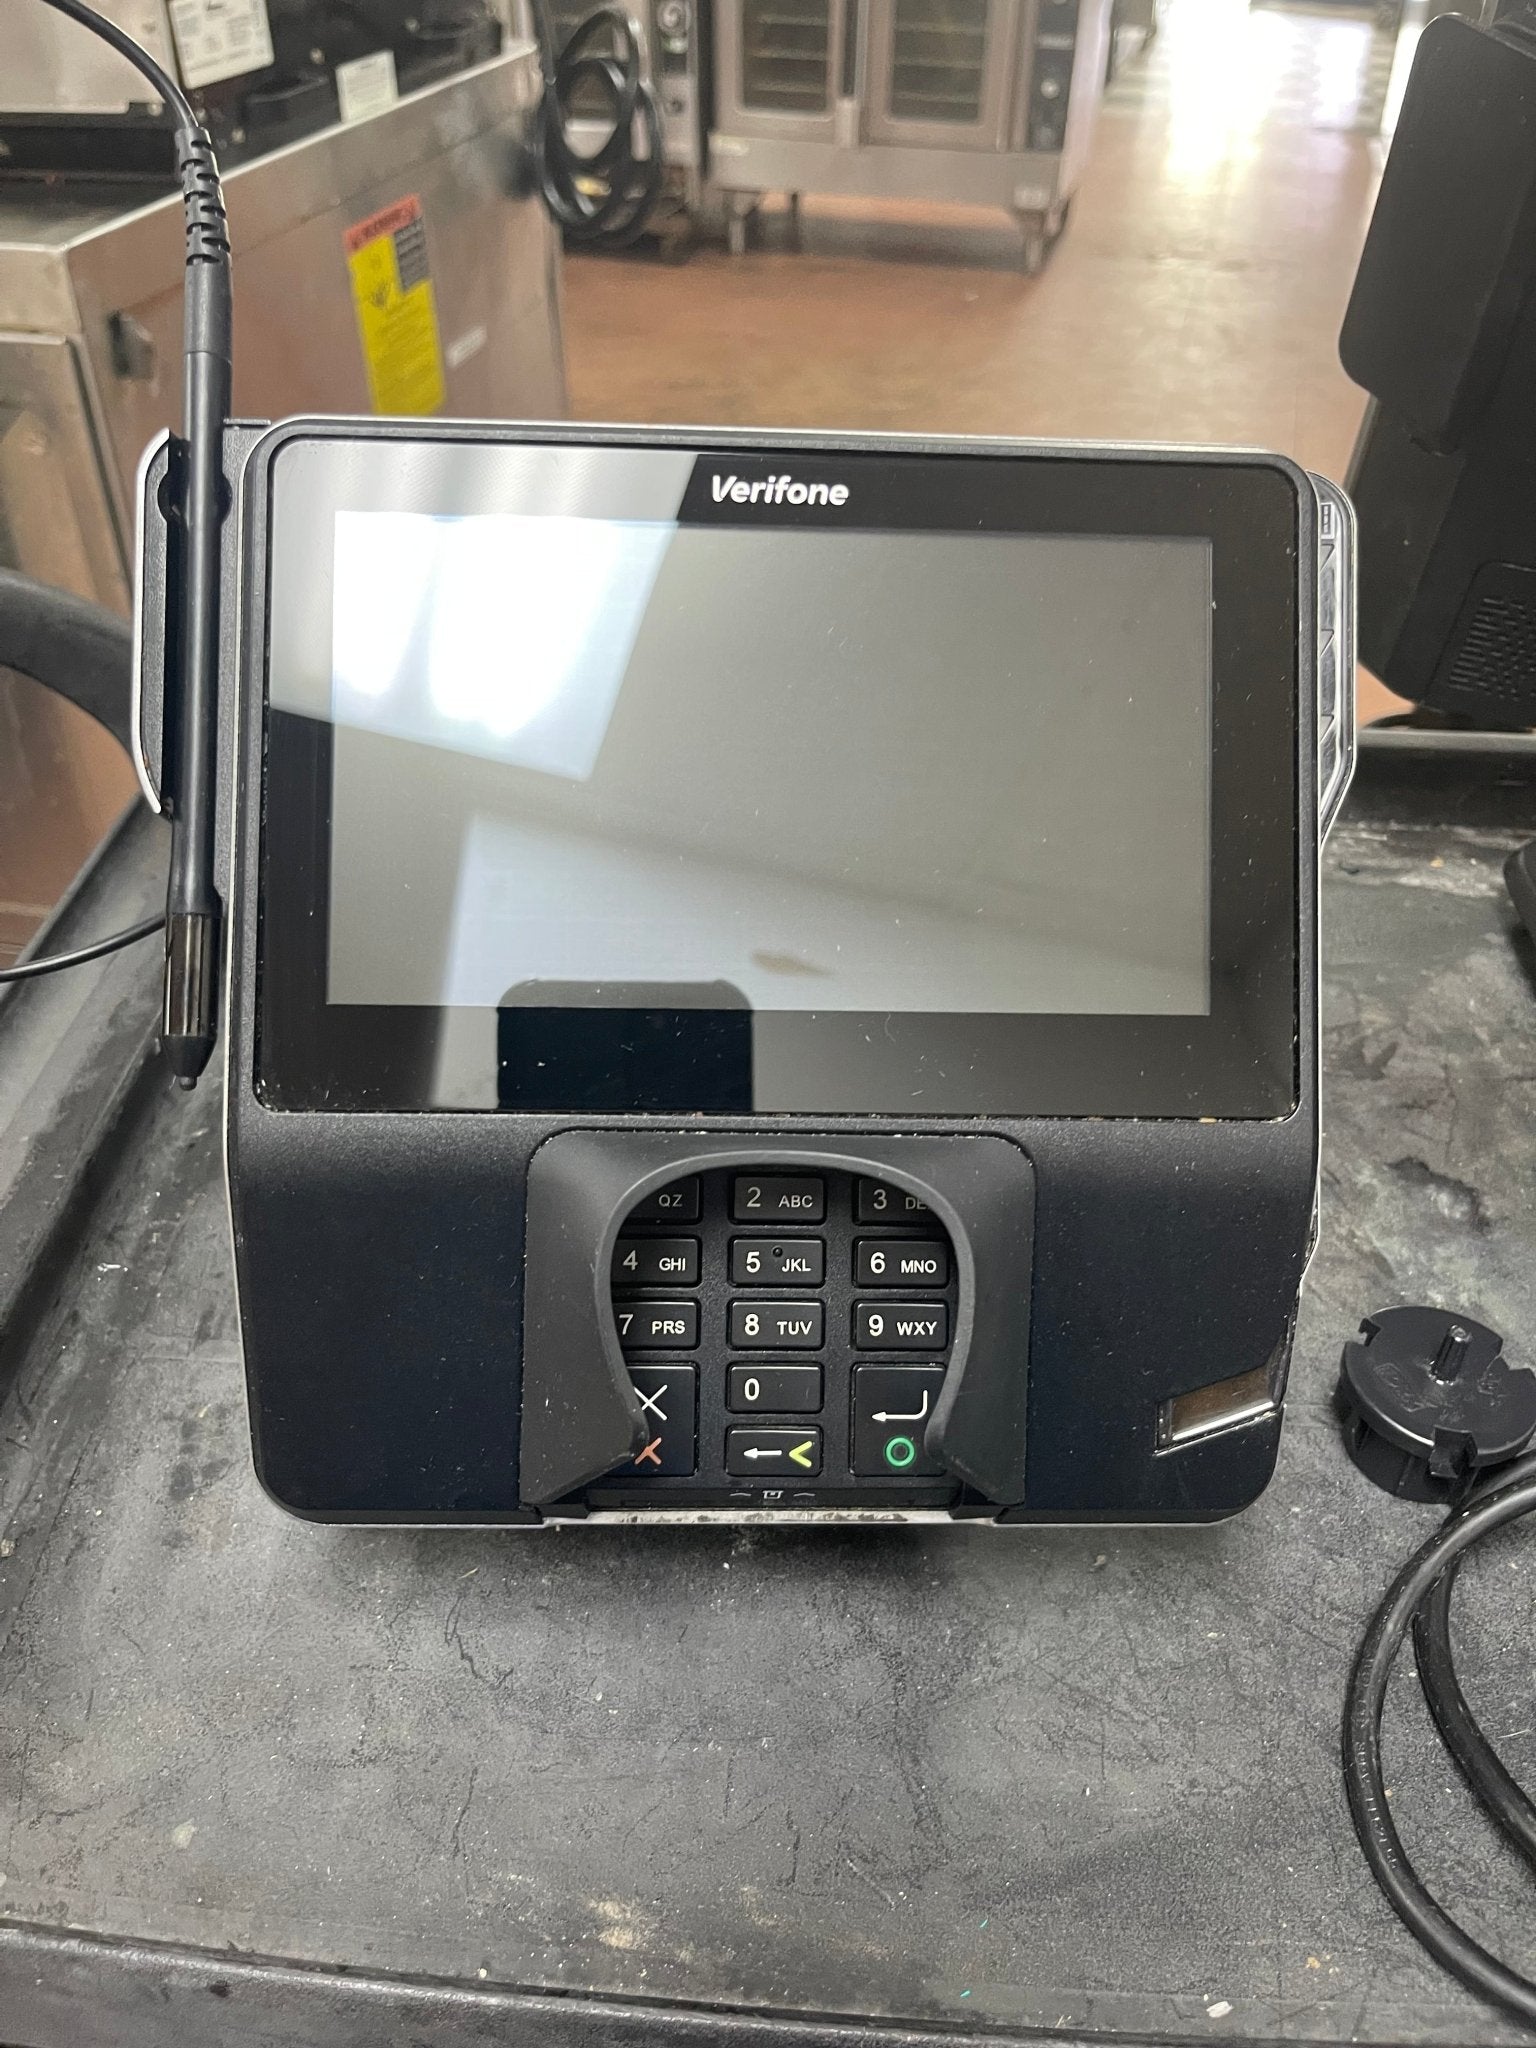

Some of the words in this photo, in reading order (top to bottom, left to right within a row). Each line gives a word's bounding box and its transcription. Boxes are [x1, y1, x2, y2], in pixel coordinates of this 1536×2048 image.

[712, 475, 849, 505] Verifone
[658, 1194, 683, 1207] QZ
[746, 1187, 761, 1208] 2
[778, 1195, 813, 1208] ABC
[873, 1189, 888, 1210] 3
[905, 1197, 927, 1210] DE
[622, 1249, 638, 1271] 4
[658, 1258, 686, 1272] GHI
[746, 1251, 761, 1273] 5
[781, 1258, 812, 1273] JKL
[870, 1252, 886, 1274] 6
[900, 1259, 937, 1274] MNO
[618, 1314, 634, 1335] 7
[651, 1320, 686, 1335] PRS
[744, 1313, 760, 1335] 8
[777, 1321, 813, 1335] TUV
[868, 1314, 884, 1336] 9
[896, 1321, 938, 1336] WXY
[744, 1378, 760, 1401] 0
